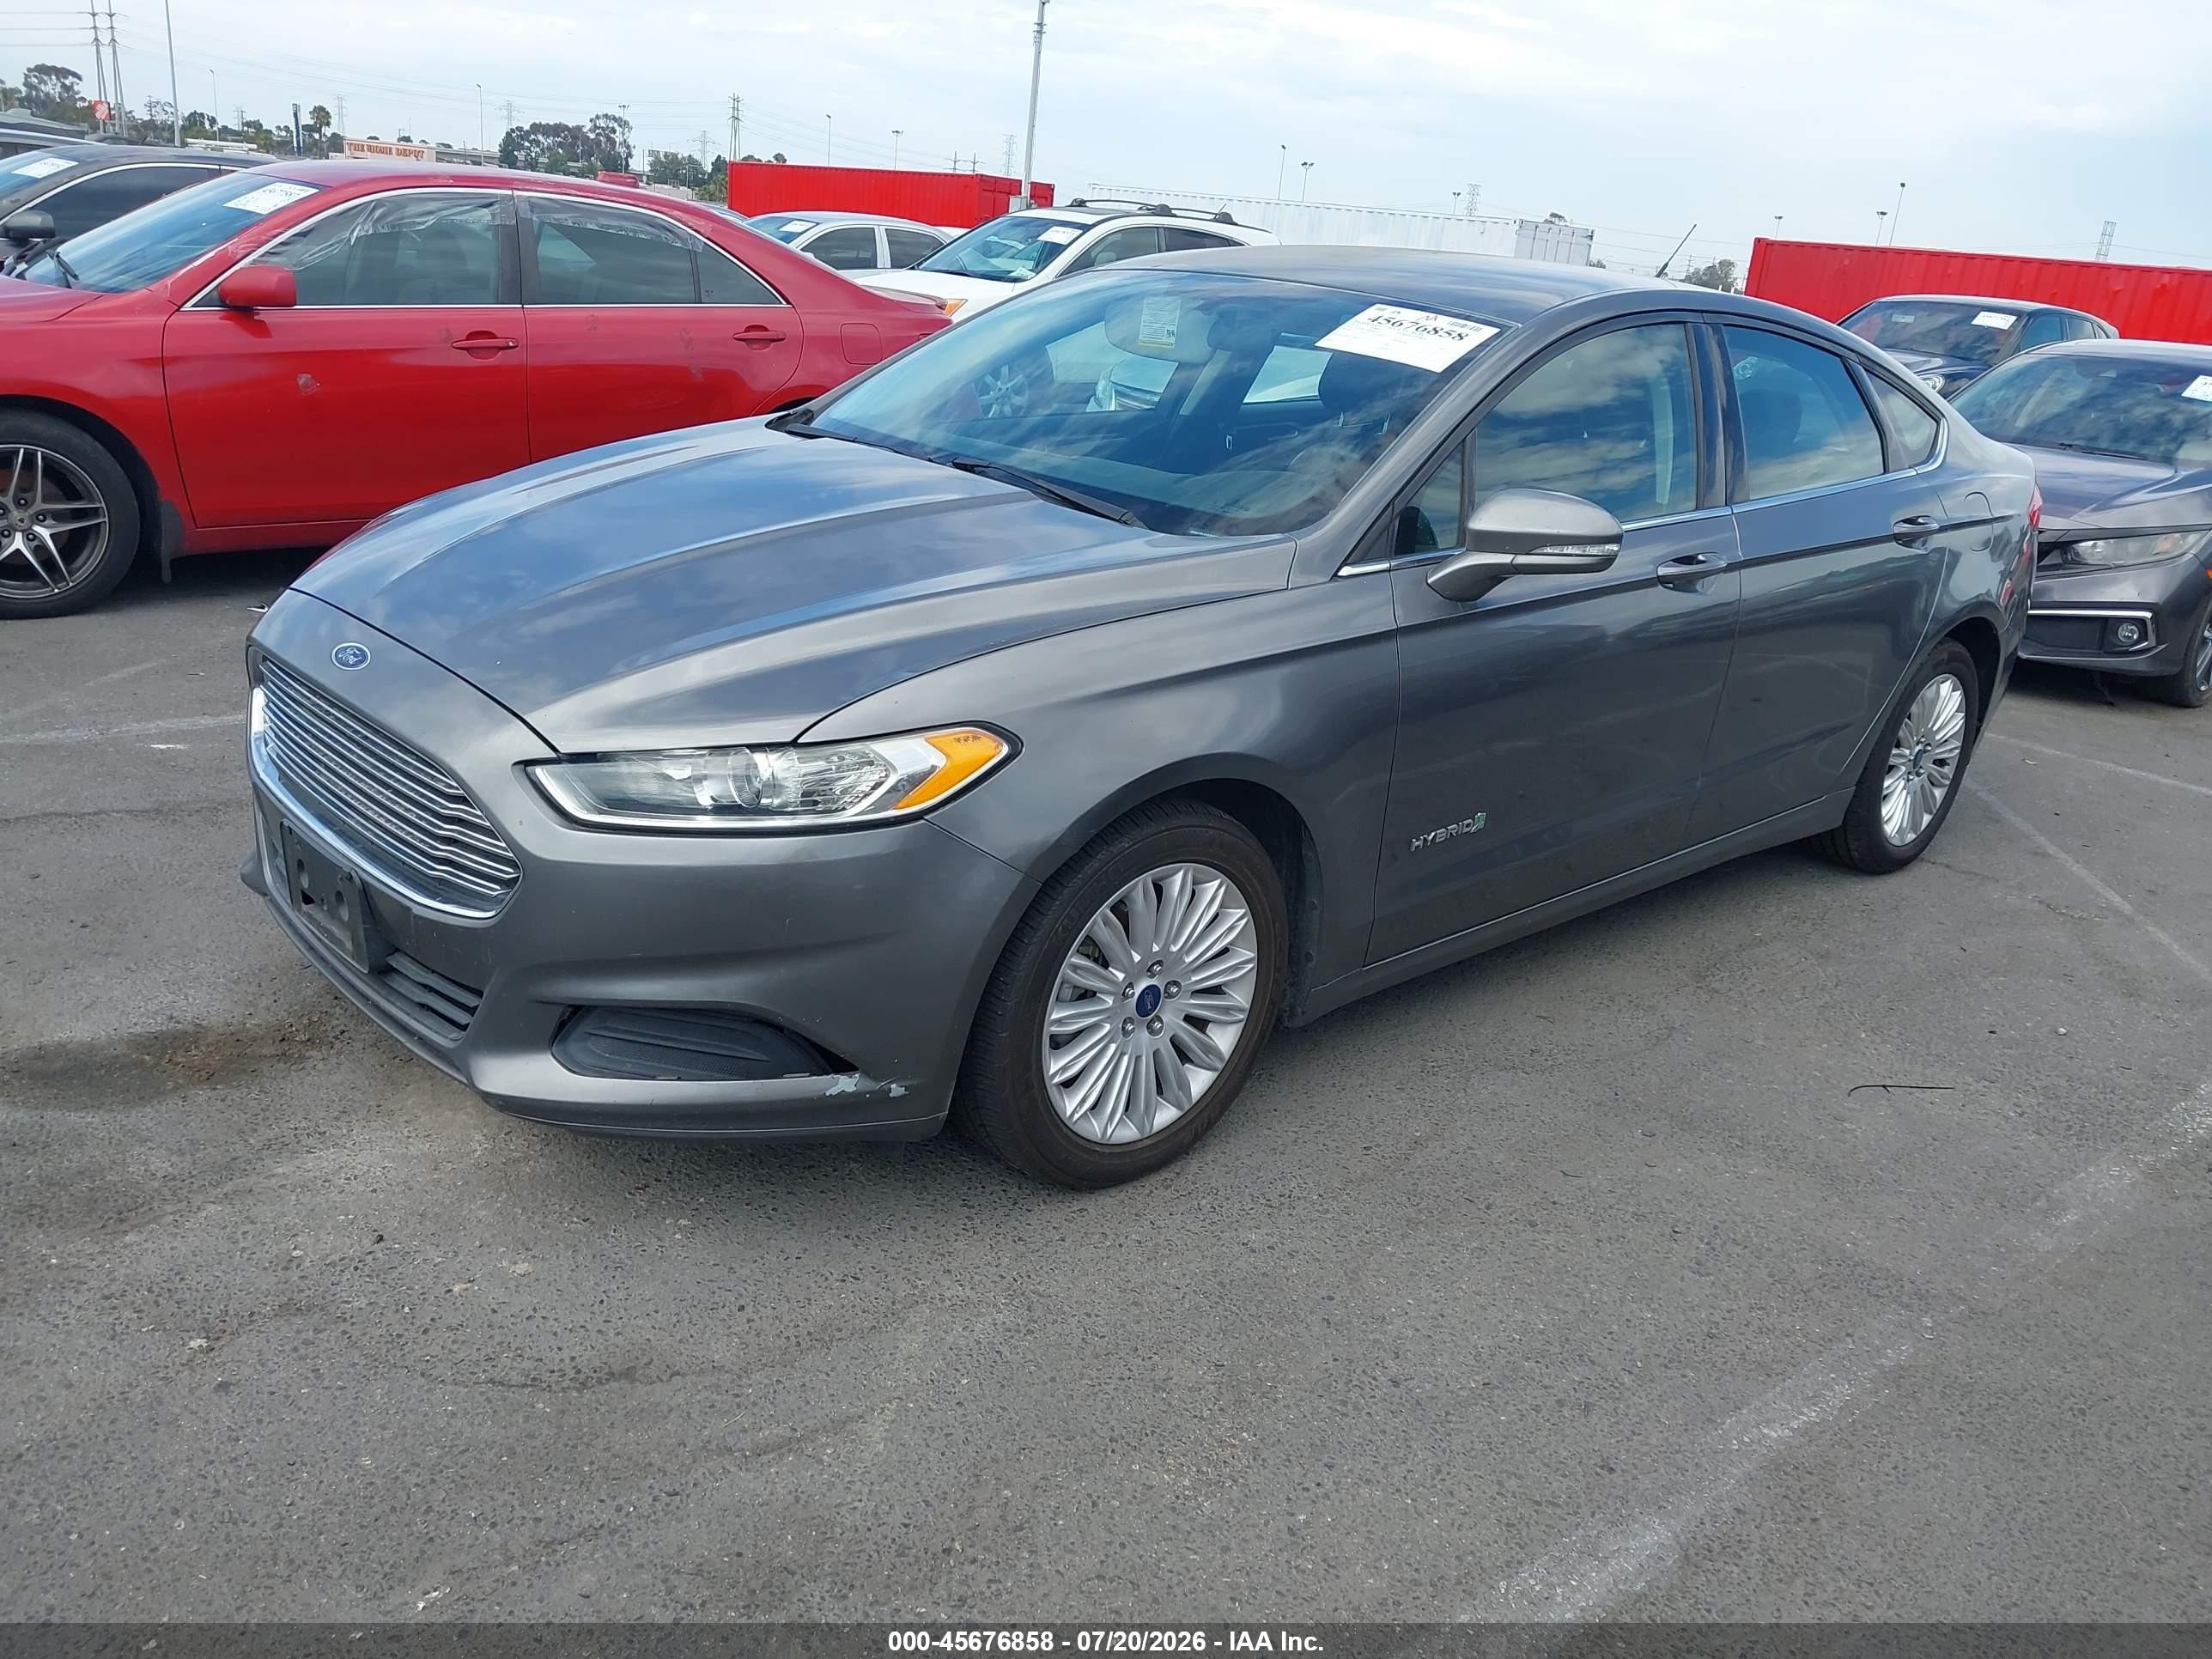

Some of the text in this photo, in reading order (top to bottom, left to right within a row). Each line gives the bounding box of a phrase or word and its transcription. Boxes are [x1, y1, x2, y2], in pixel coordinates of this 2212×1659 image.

[395, 147, 425, 159] DEPOT
[1367, 315, 1469, 342] 45676858
[1410, 818, 1474, 853] HYBRID
